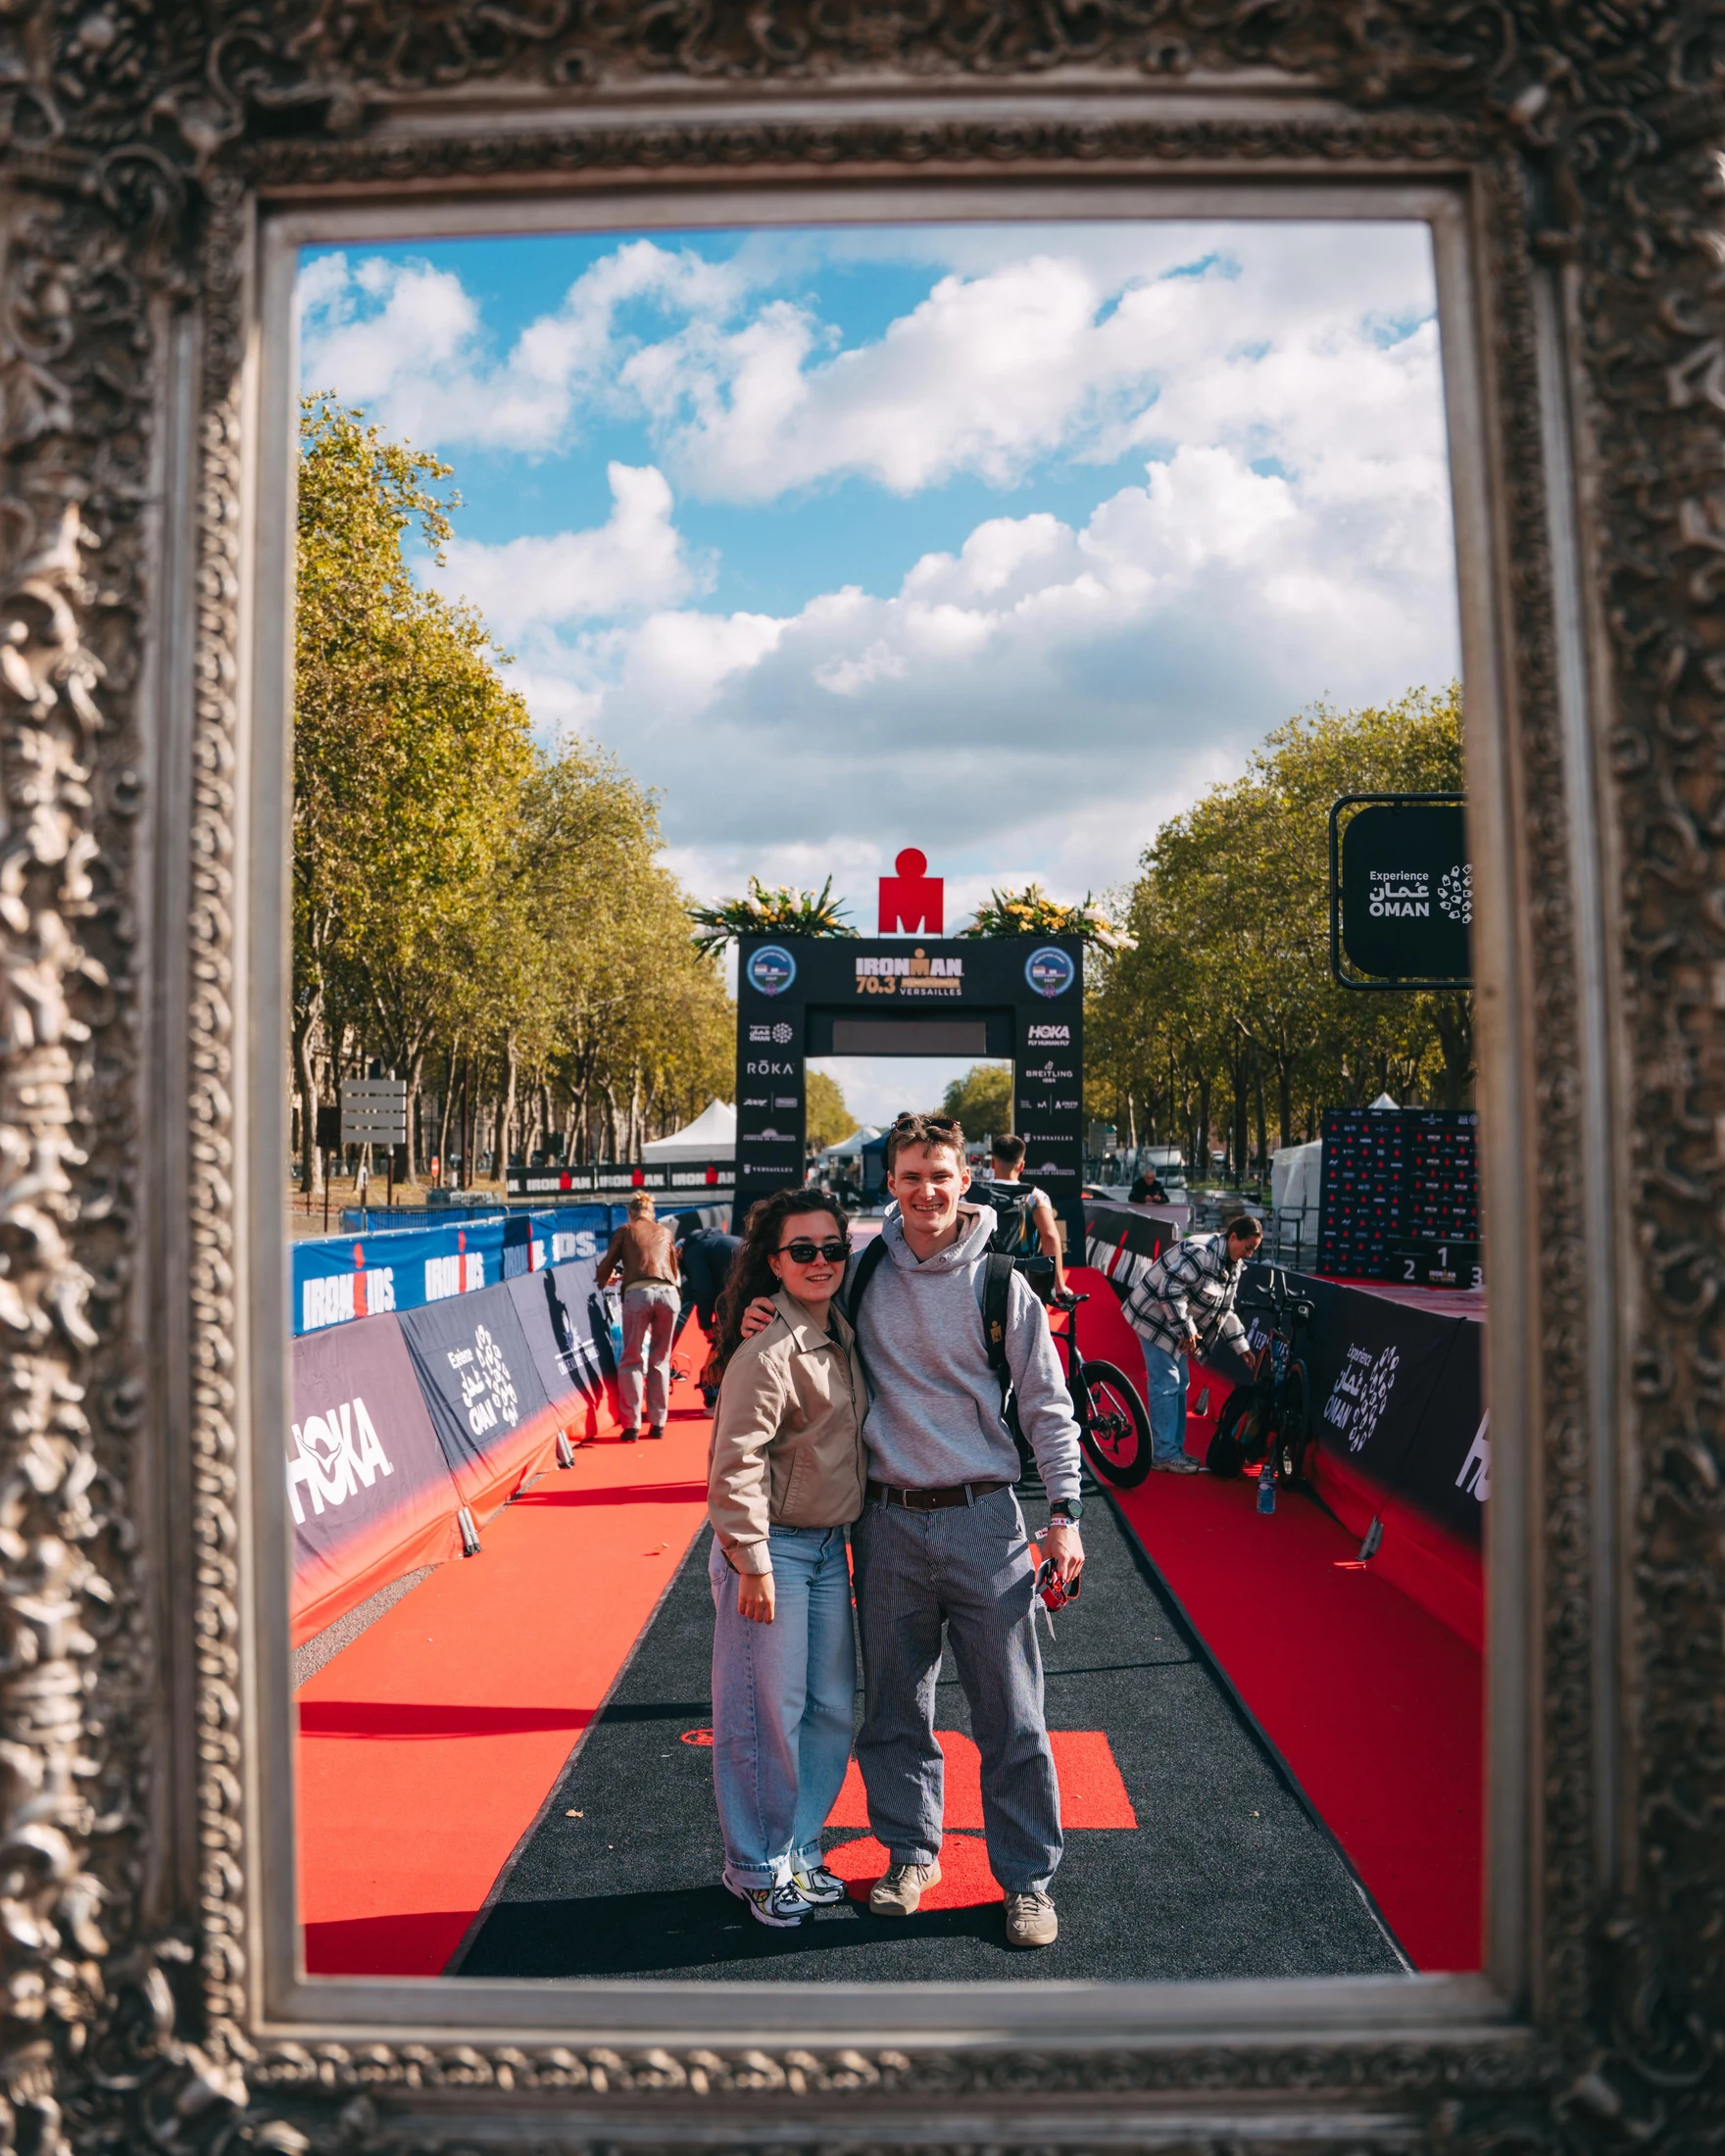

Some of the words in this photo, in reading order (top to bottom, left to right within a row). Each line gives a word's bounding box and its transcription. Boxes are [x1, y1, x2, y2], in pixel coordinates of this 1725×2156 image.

[1369, 870, 1429, 882] Experience
[1368, 902, 1430, 917] OMAN
[856, 949, 962, 976] IRONMAN
[856, 976, 896, 994] 70.3
[900, 988, 962, 997] VERSAILLES
[1028, 1025, 1070, 1039] HOKA
[1437, 1247, 1448, 1267] 1
[1404, 1259, 1415, 1280] 2
[1470, 1266, 1483, 1287] 3
[1323, 1394, 1353, 1430] OMAN
[286, 1396, 392, 1525] HOKA
